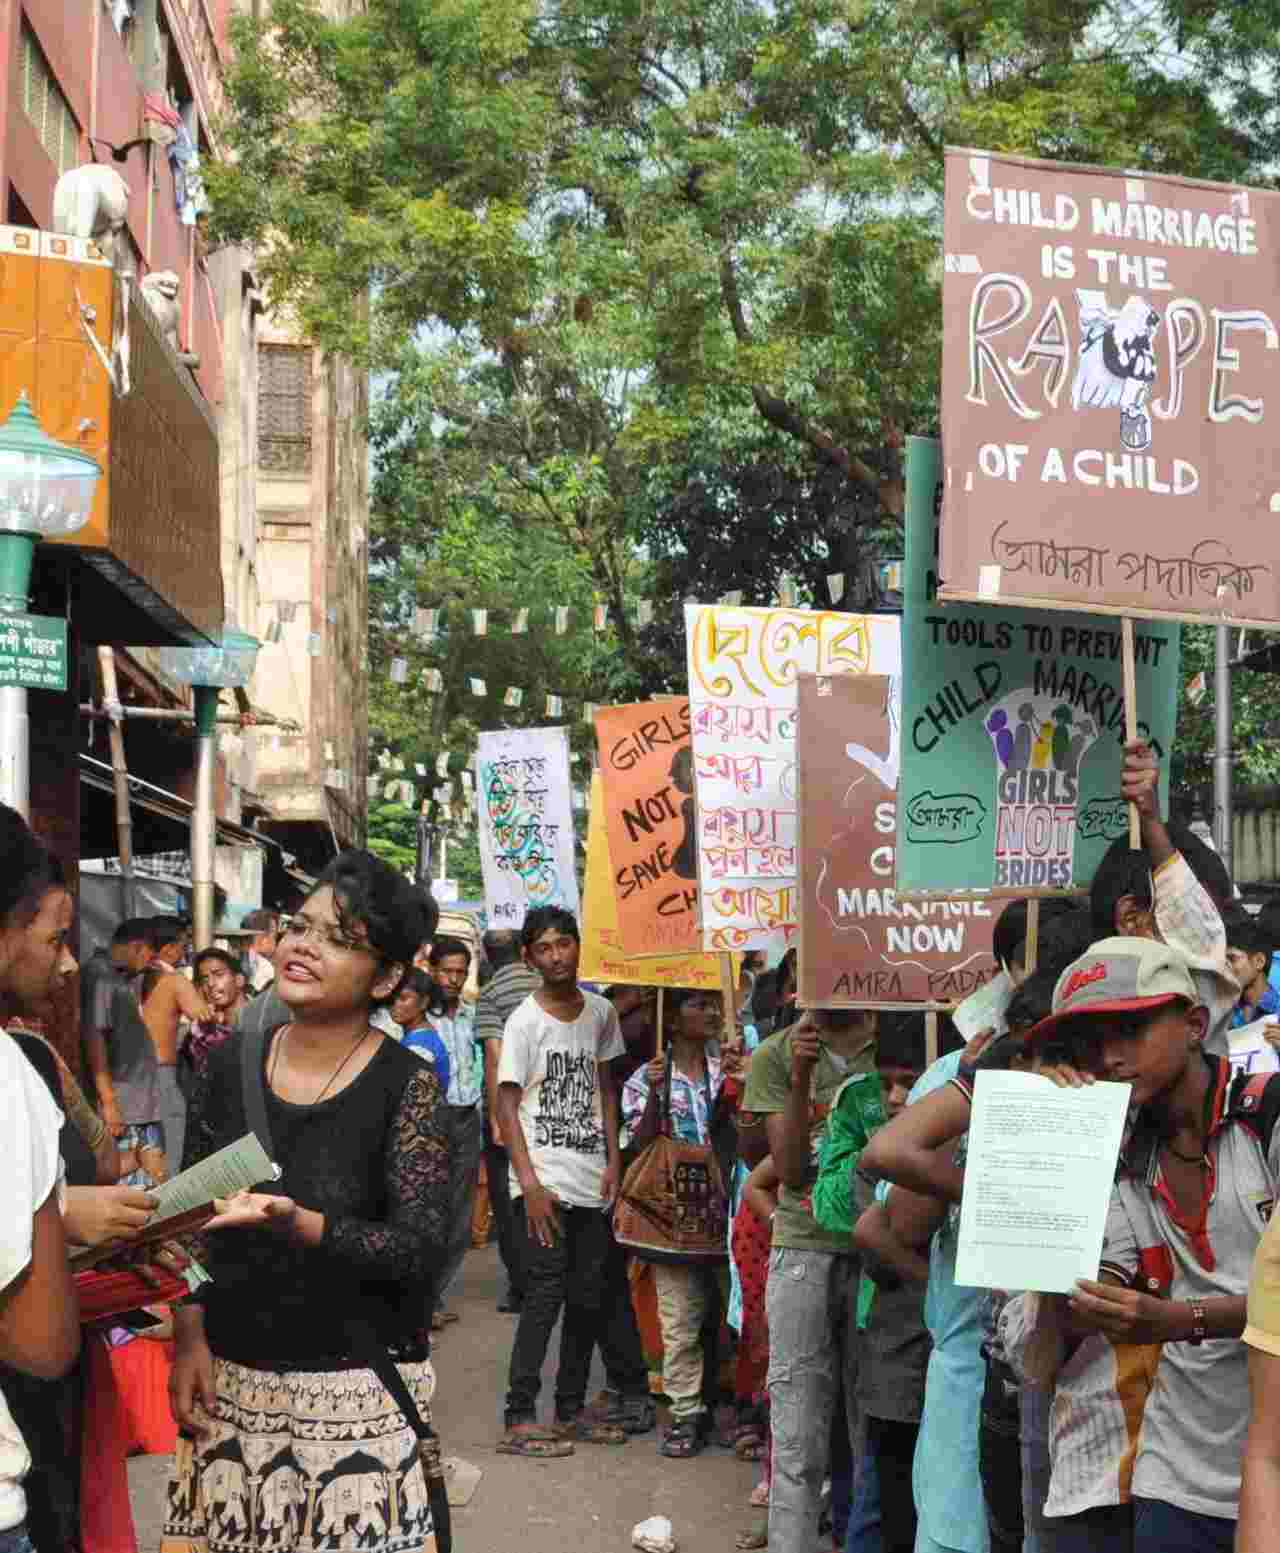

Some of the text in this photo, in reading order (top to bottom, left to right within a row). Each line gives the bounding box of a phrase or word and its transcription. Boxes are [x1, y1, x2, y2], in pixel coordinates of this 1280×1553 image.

[967, 185, 1257, 254] CHILD MARRIAGE
[1041, 245, 1172, 290] IS THE
[967, 271, 1279, 423] RAPE
[979, 443, 1199, 495] OF A CHILD
[925, 617, 1168, 667] TOOLS TO PREVNT
[912, 661, 1002, 753] CHILD
[1000, 770, 1077, 803] GIRLS
[622, 787, 678, 843] NOT
[996, 804, 1075, 857] NOT
[616, 841, 676, 899] SAVE
[995, 859, 1073, 887] BRIDES
[886, 921, 965, 953] NOW
[832, 971, 903, 996] AMRA
[927, 969, 996, 995] PADA
